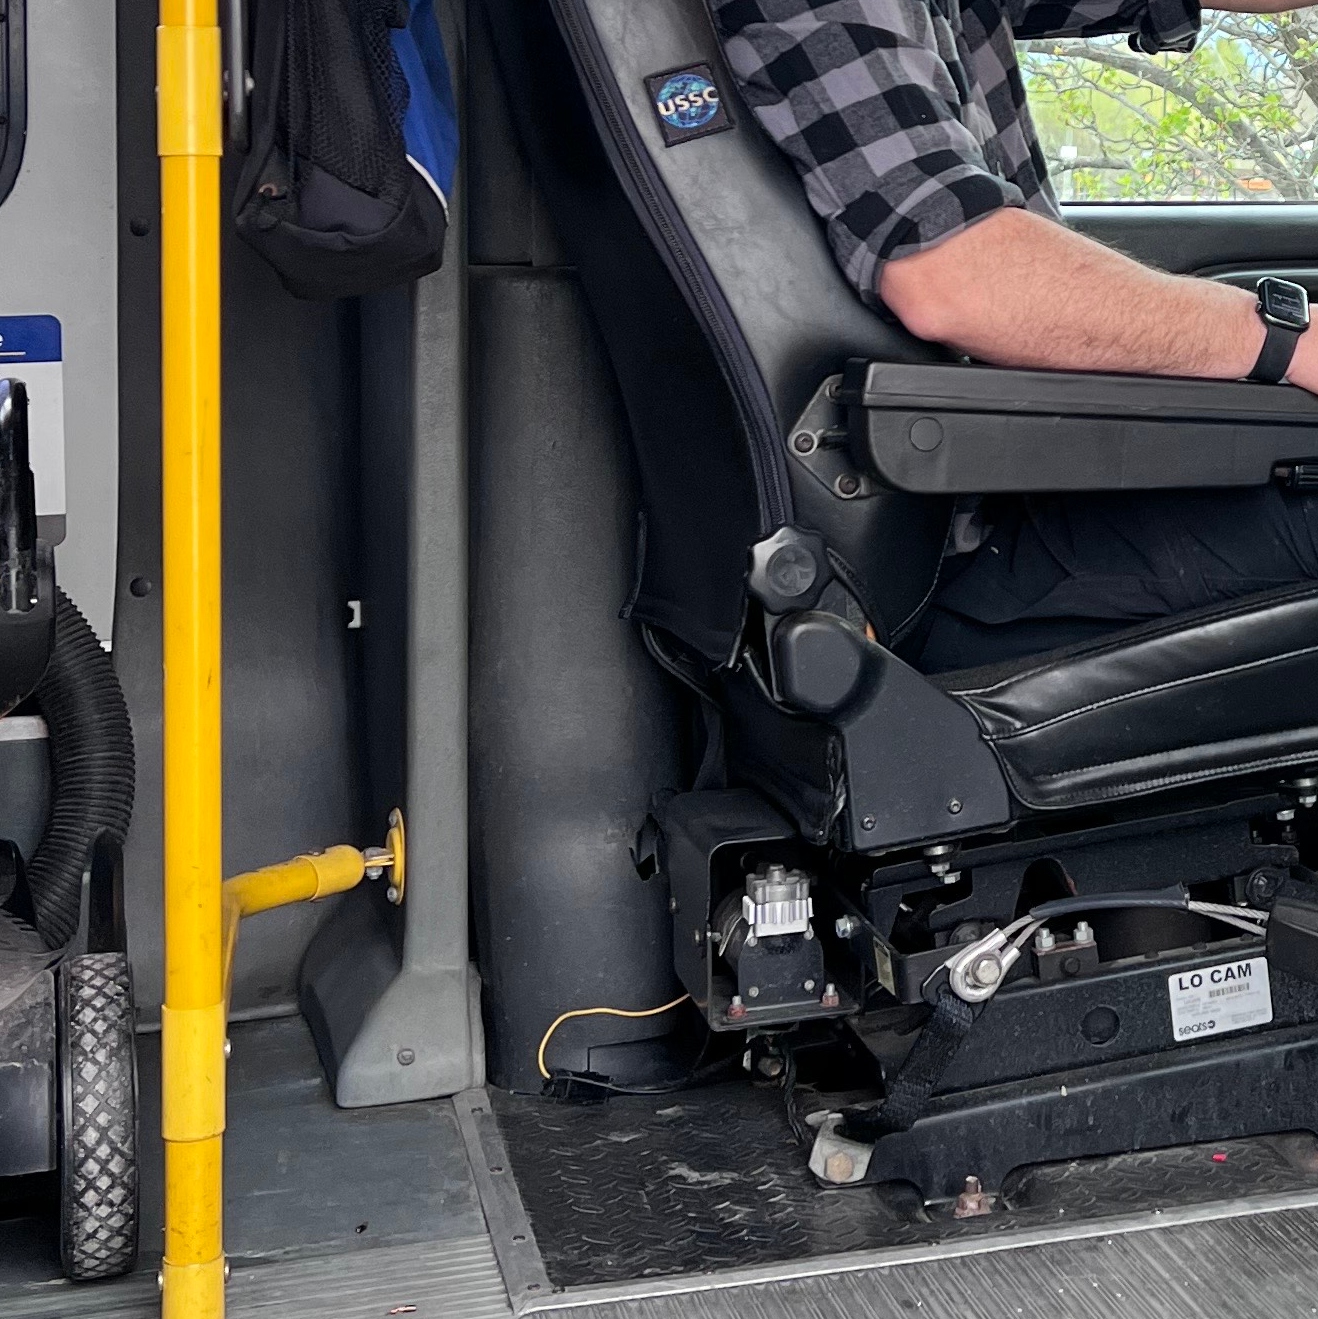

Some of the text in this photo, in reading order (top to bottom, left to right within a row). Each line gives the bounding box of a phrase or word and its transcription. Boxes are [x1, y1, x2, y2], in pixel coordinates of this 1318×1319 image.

[656, 86, 719, 116] USSC
[1178, 962, 1252, 991] LO CAM
[1178, 1021, 1208, 1036] seats
